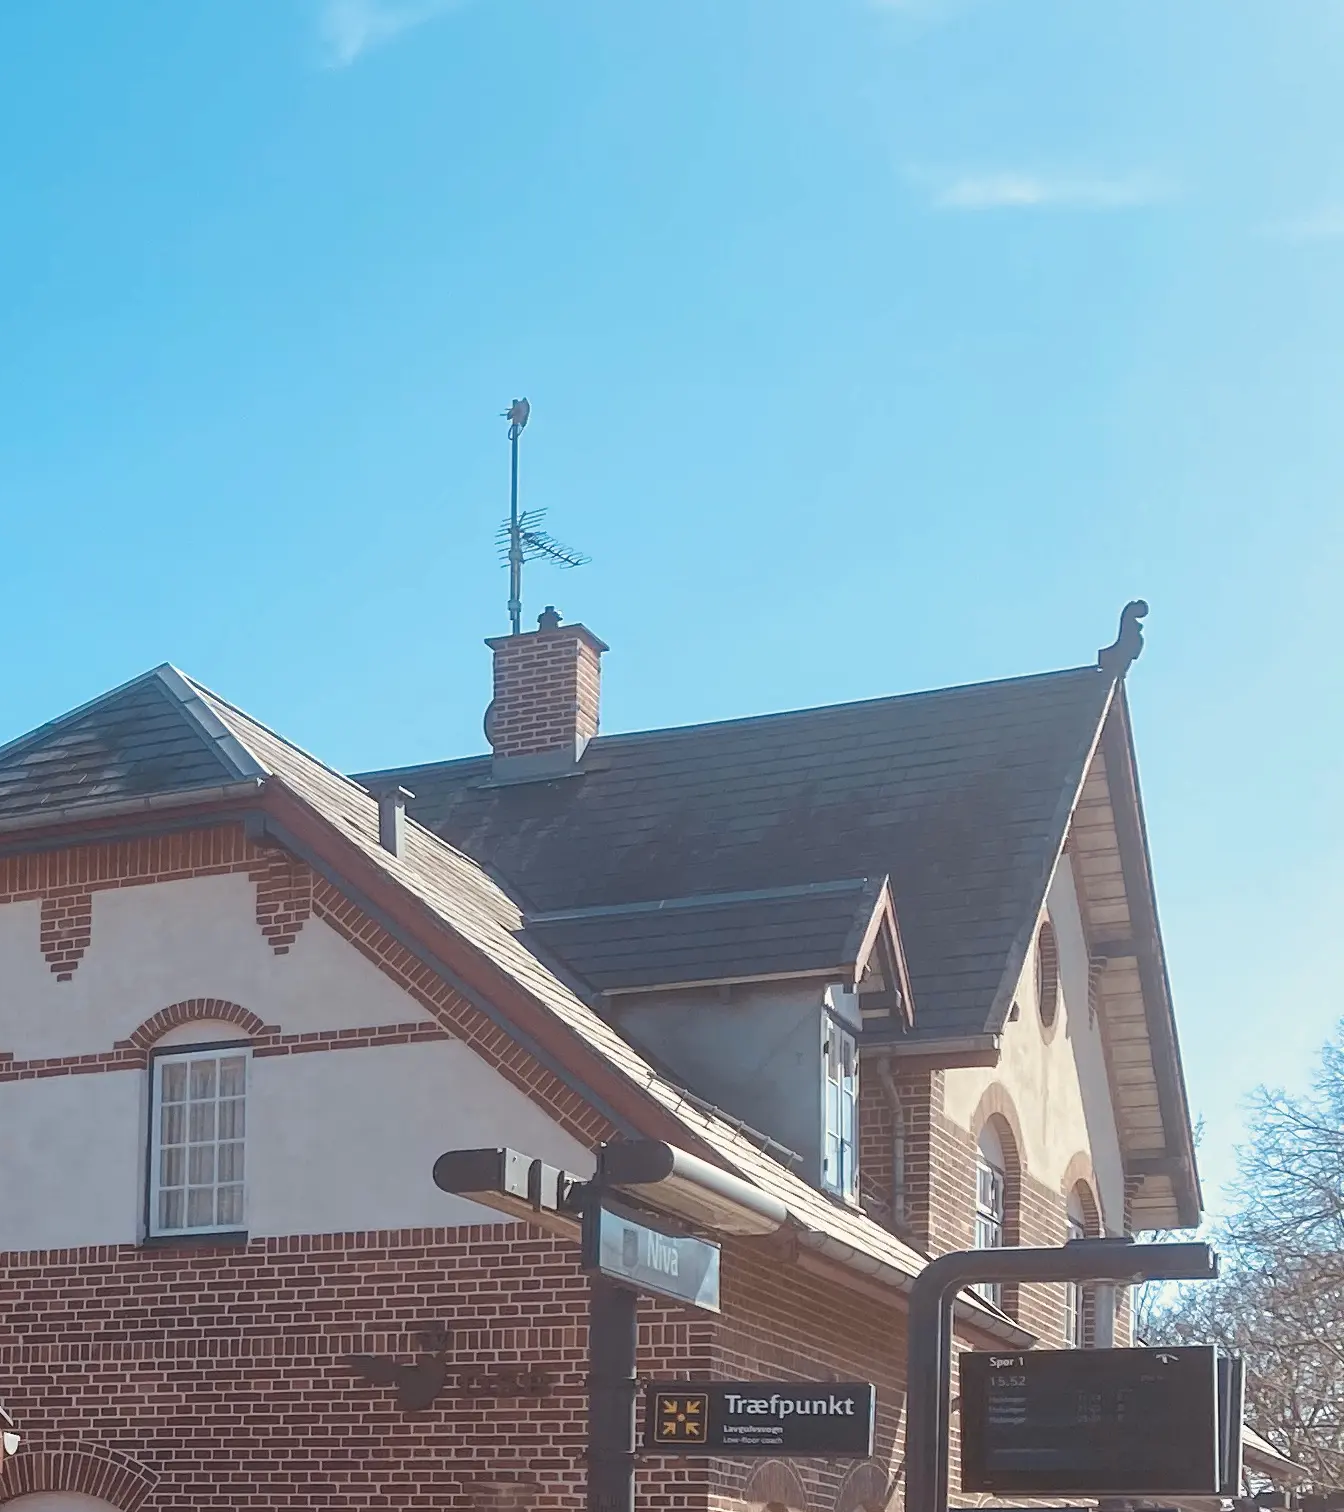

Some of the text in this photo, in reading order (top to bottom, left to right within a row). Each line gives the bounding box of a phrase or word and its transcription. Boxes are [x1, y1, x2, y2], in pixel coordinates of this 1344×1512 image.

[989, 1357, 1025, 1368] Spor 1
[724, 1394, 855, 1419] Træfpunkt
